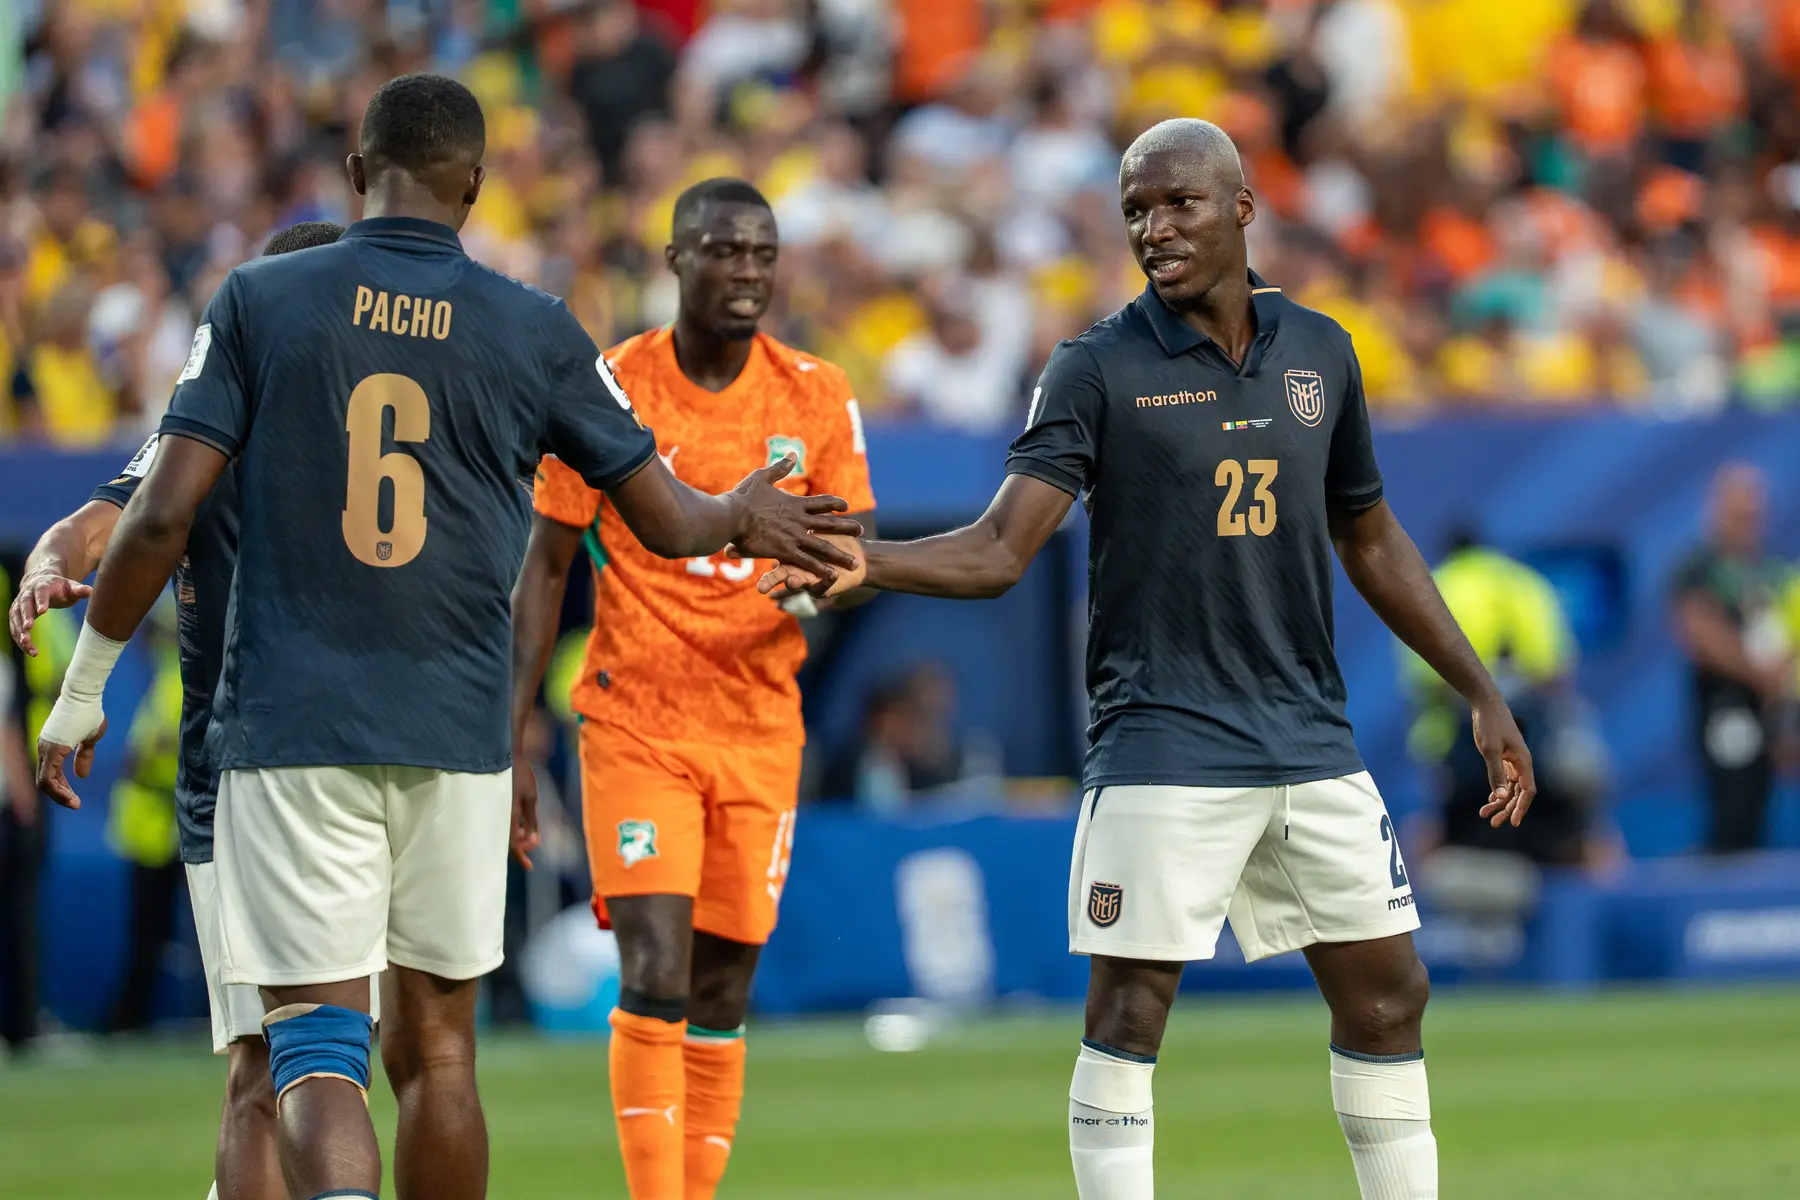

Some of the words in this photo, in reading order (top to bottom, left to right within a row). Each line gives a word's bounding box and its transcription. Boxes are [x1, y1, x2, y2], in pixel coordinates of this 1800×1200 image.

[353, 285, 452, 340] PACHO
[1135, 389, 1217, 409] marathon
[342, 373, 431, 567] 6
[1215, 459, 1278, 536] 23
[1073, 1116, 1148, 1126] marathon
